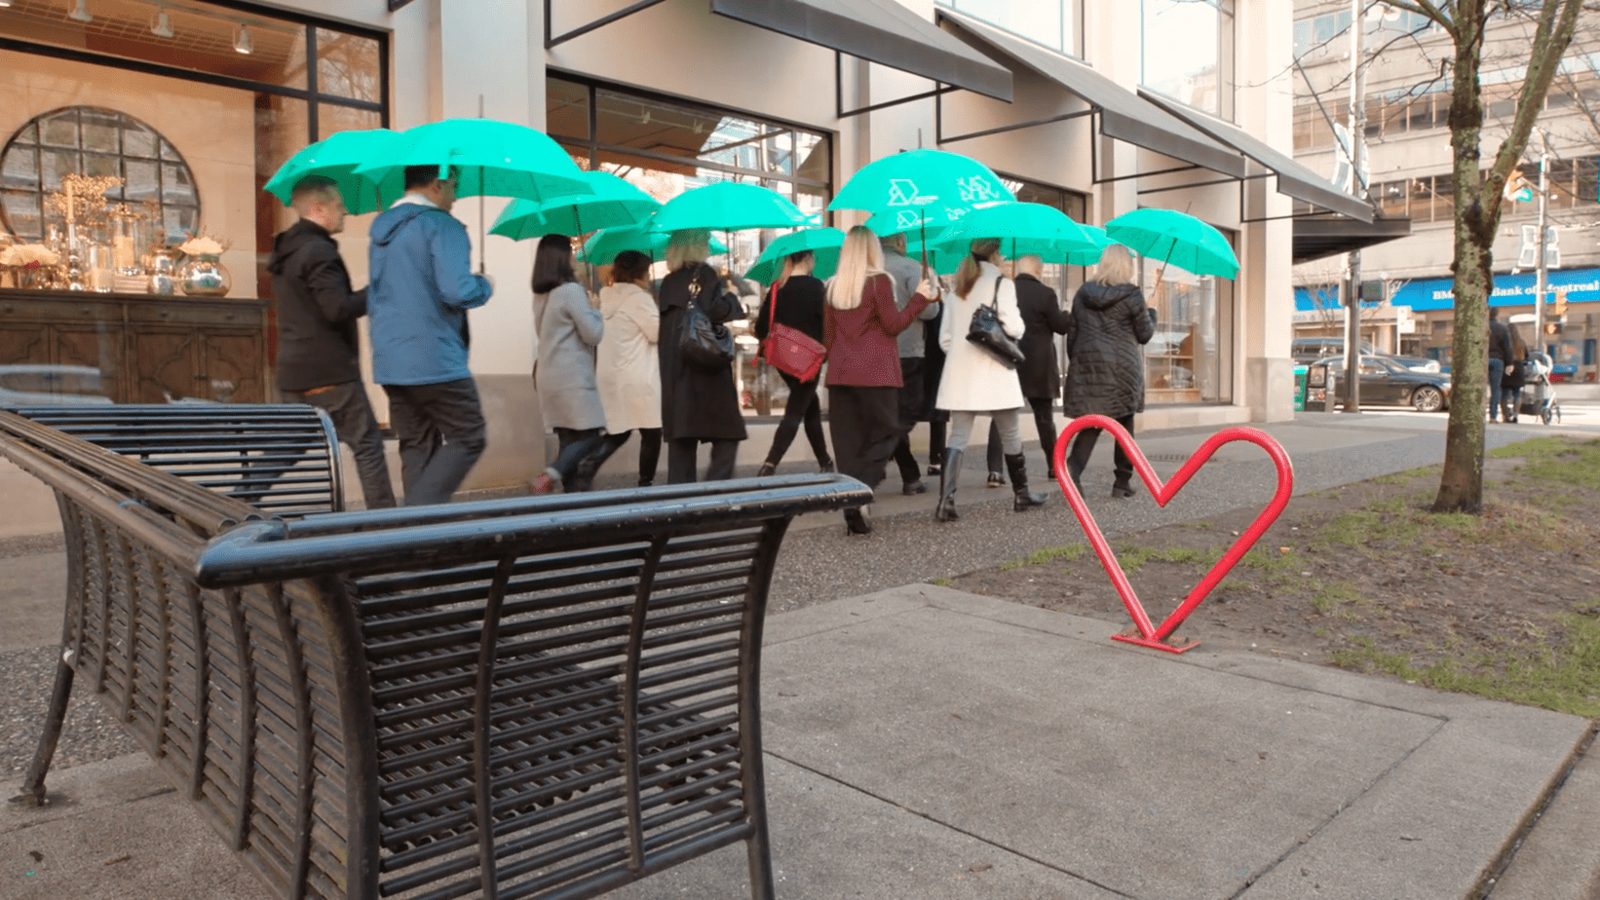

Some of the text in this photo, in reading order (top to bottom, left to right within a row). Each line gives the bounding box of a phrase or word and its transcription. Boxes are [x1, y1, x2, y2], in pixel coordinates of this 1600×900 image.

[1432, 289, 1455, 300] BM
[1491, 286, 1523, 297] Bank
[1524, 285, 1539, 295] of
